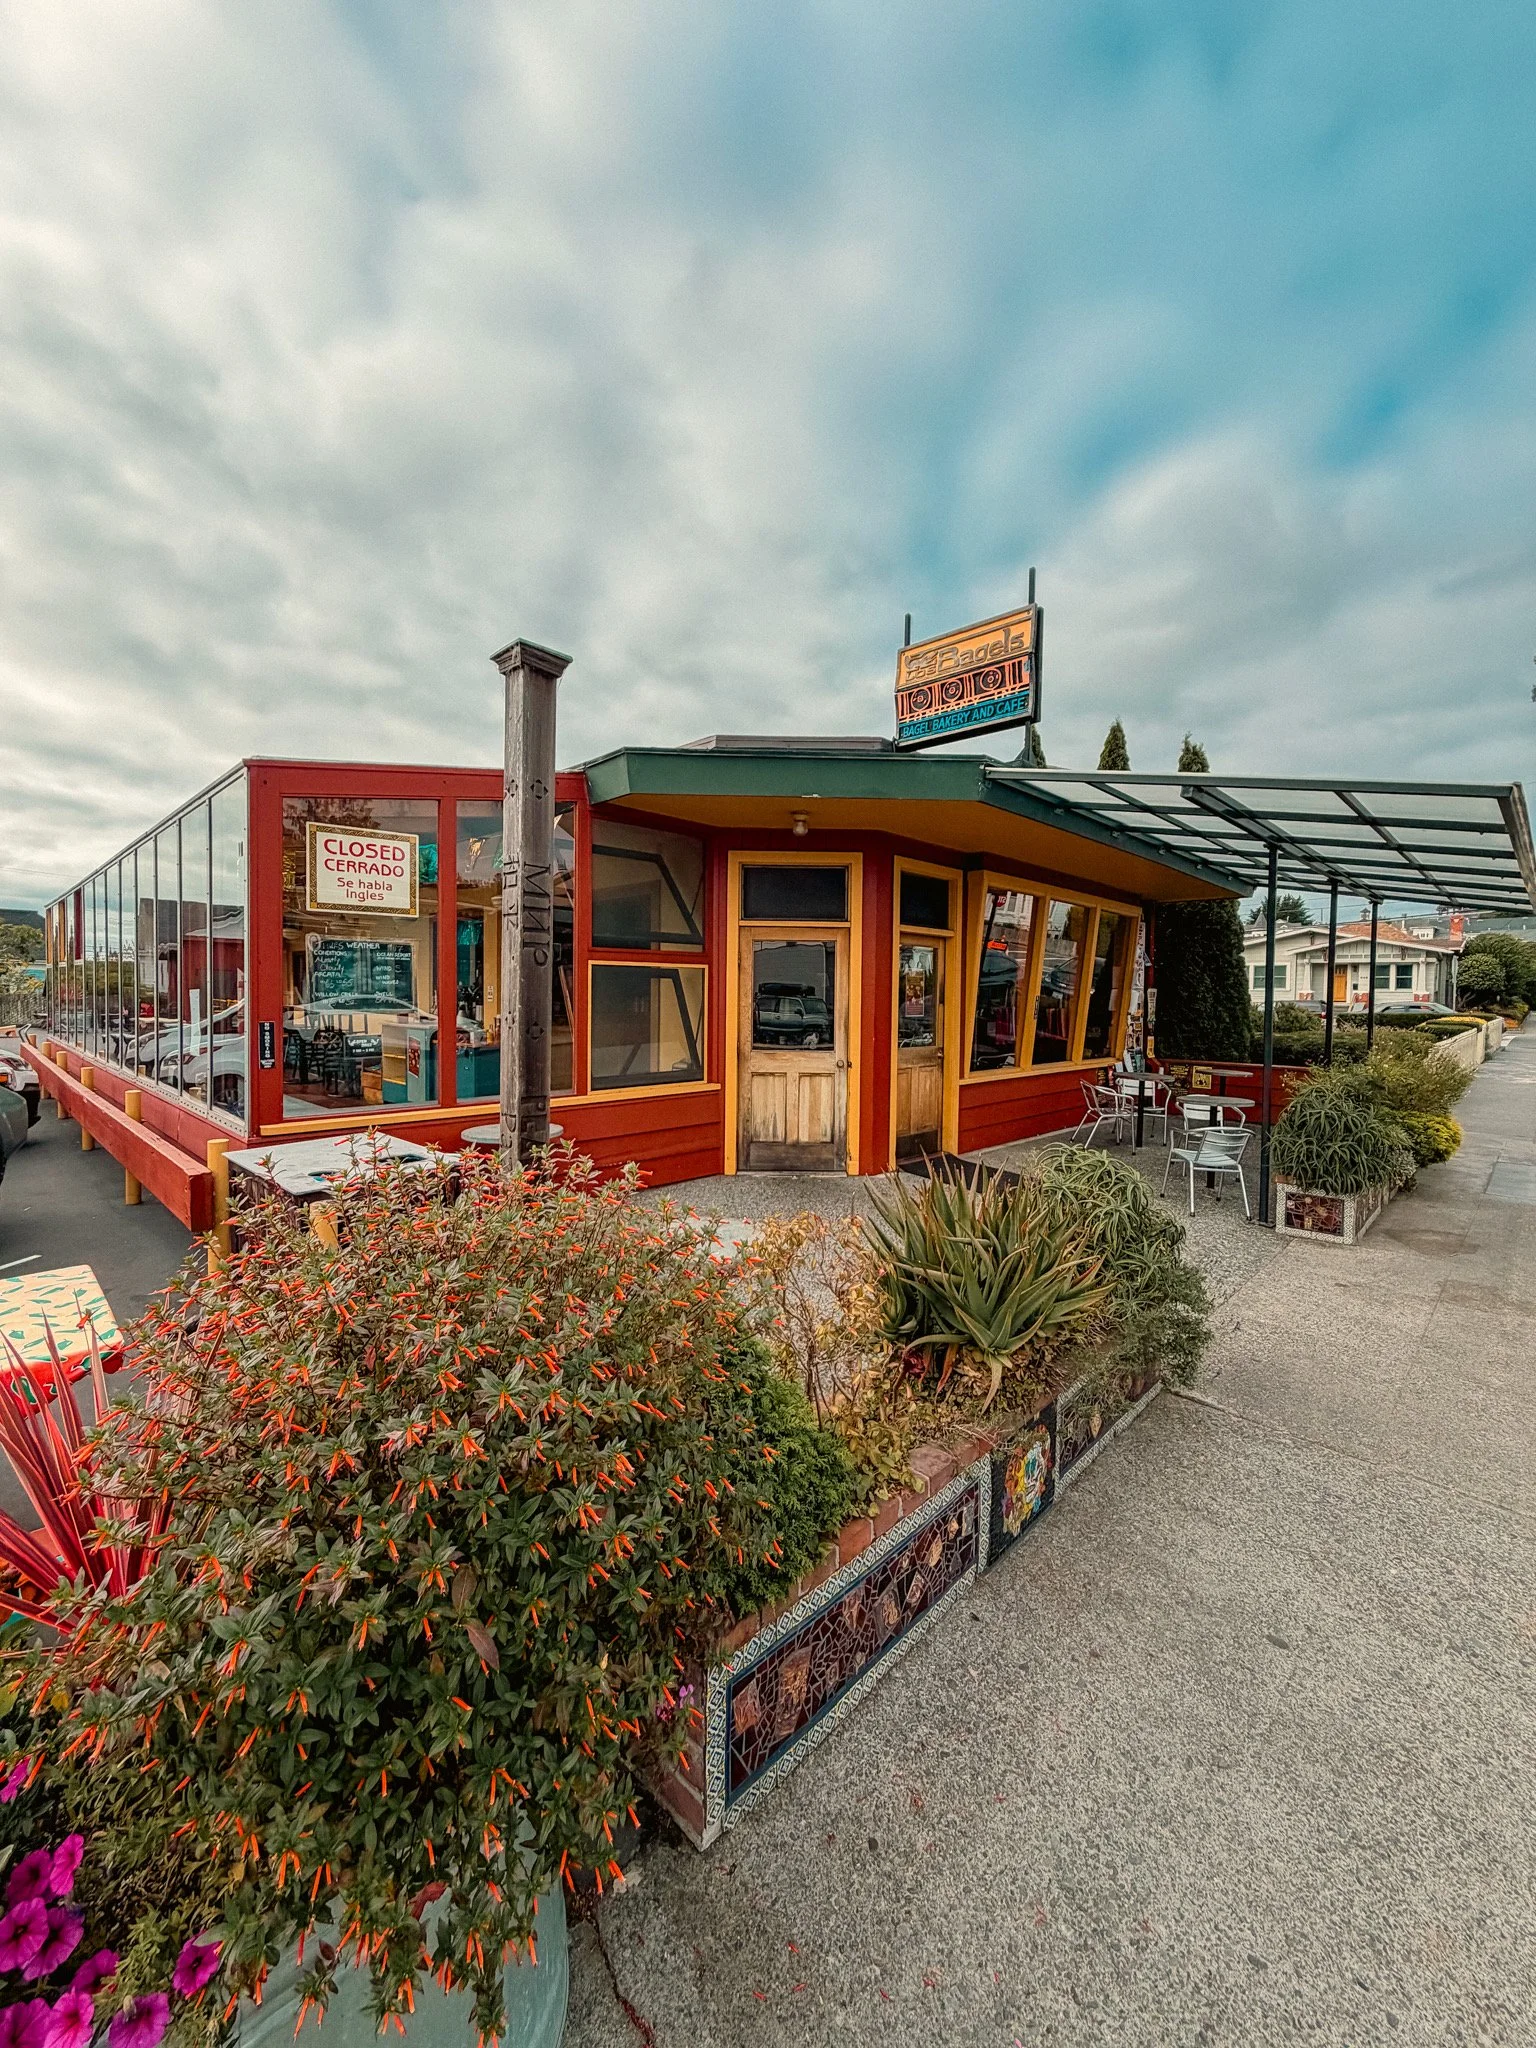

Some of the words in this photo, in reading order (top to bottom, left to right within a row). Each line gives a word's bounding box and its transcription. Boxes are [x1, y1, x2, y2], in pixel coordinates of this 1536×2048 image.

[938, 628, 1025, 671] Bagels
[903, 722, 931, 737] BAGEL
[932, 711, 970, 730] BAKERY
[971, 705, 994, 720] AND
[996, 698, 1025, 713] CAFE
[323, 838, 406, 862] CLOSED
[324, 858, 405, 878] CERRADO
[337, 877, 354, 888] Se
[358, 879, 393, 892] habla
[346, 888, 385, 902] Ingles
[346, 942, 380, 950] WEATHER
